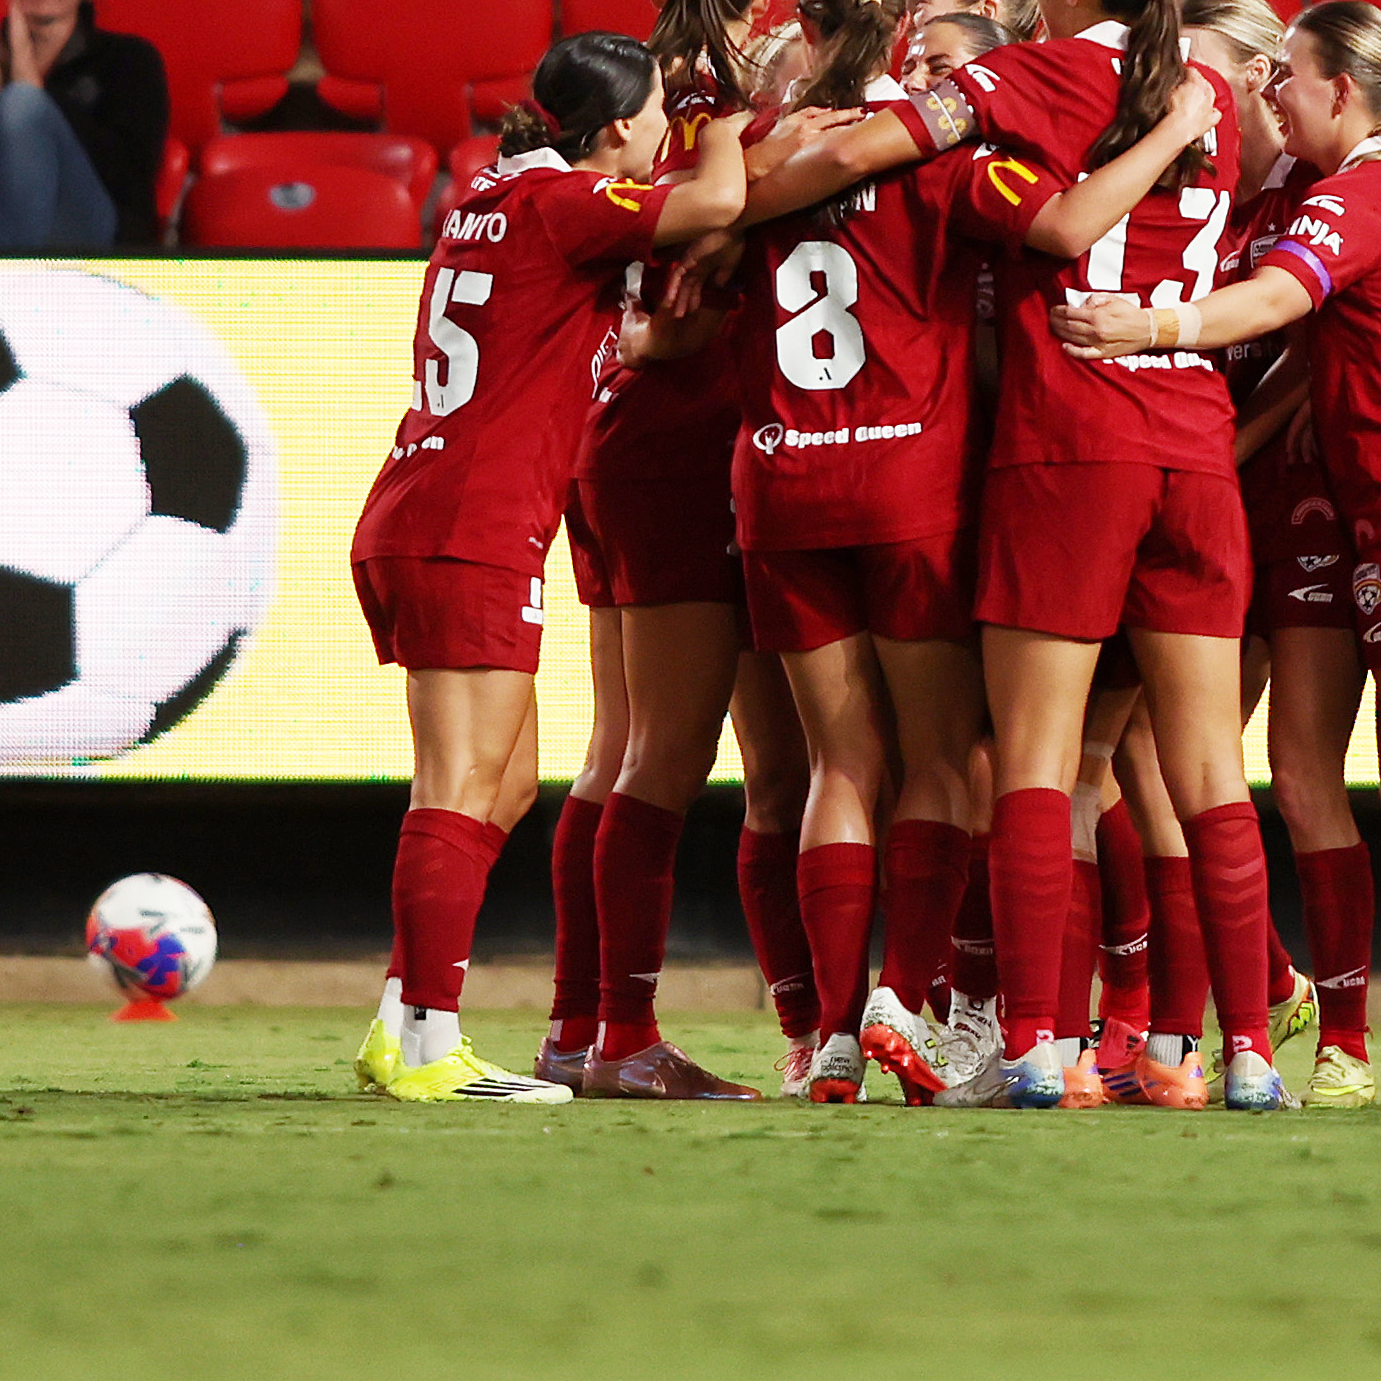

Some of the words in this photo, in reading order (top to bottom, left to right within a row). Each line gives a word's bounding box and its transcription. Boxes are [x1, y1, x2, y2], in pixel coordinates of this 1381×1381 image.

[441, 209, 508, 244] ANTO
[1283, 214, 1344, 256] INJA
[776, 240, 866, 390] 8
[784, 427, 850, 449] Speed
[854, 421, 922, 442] Queen
